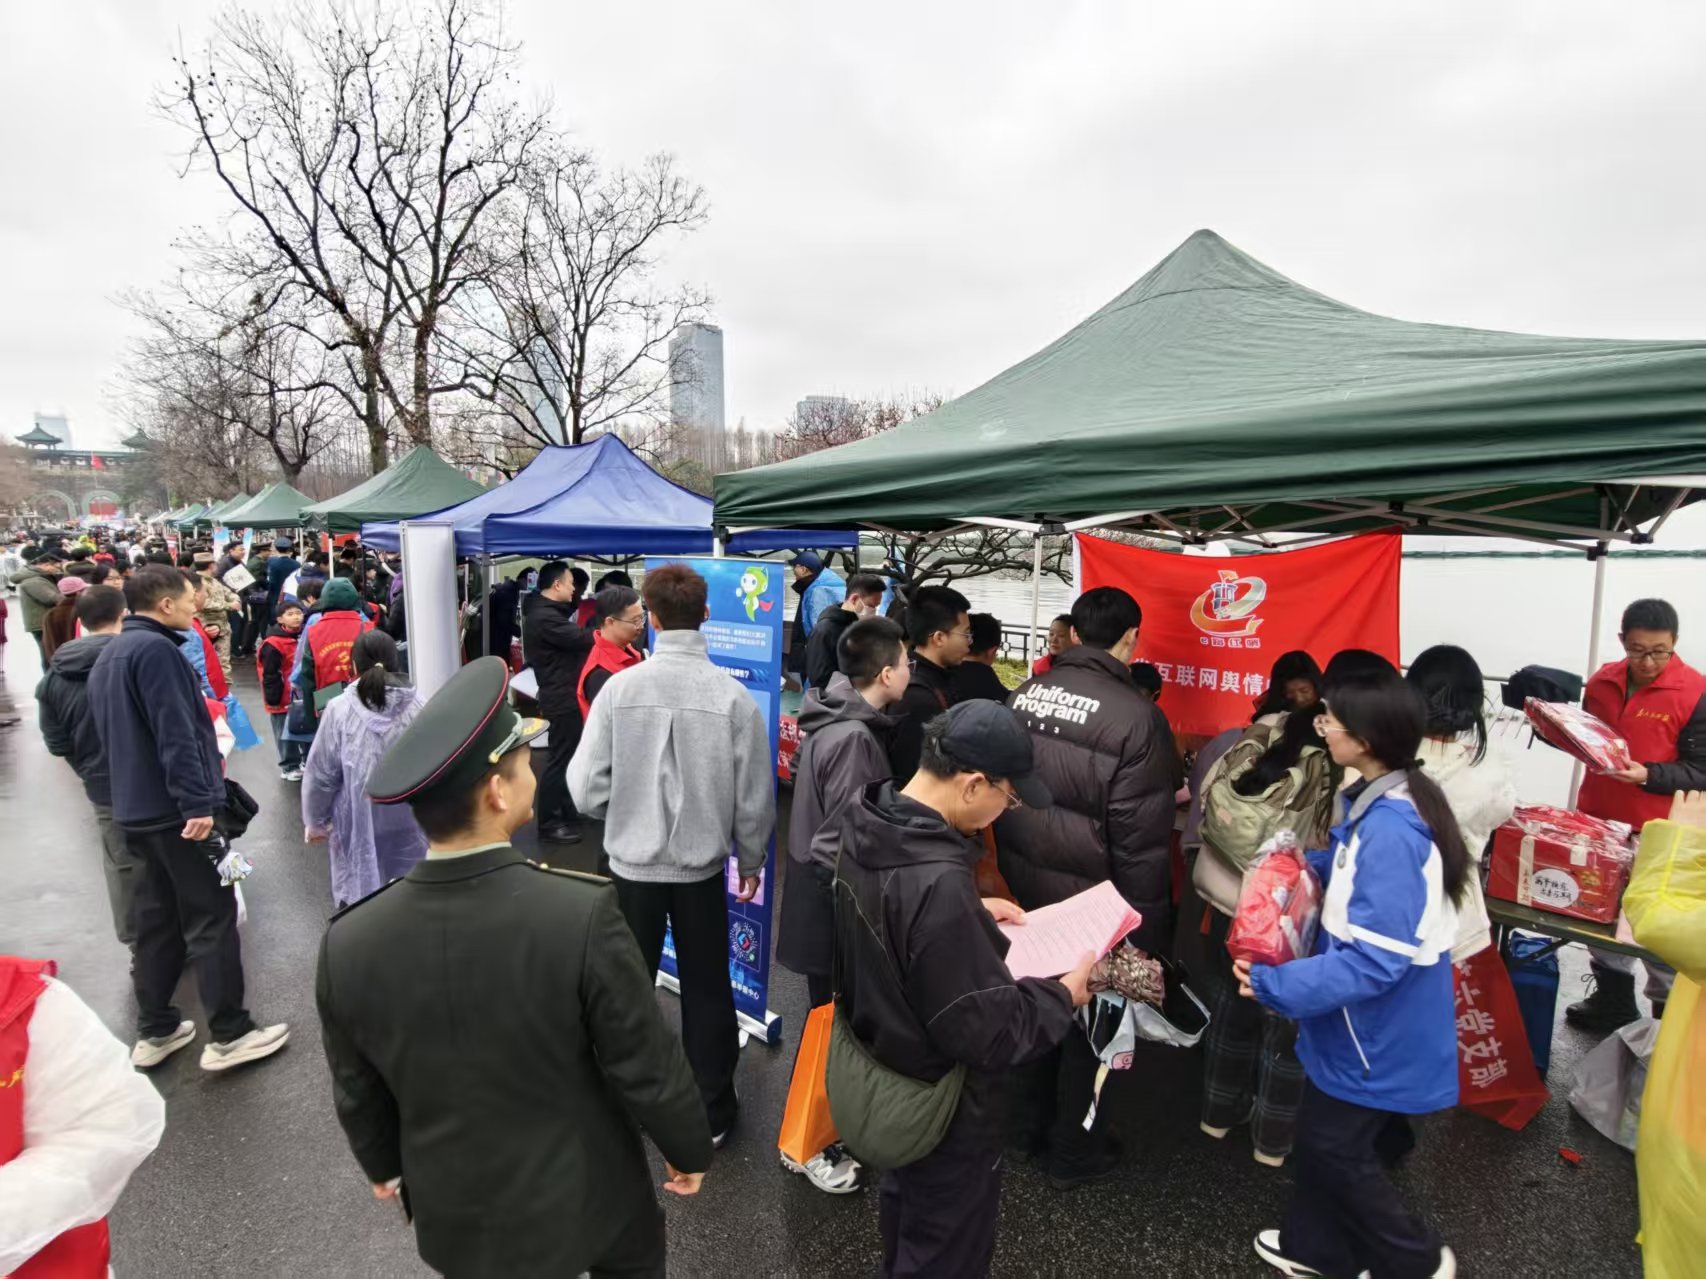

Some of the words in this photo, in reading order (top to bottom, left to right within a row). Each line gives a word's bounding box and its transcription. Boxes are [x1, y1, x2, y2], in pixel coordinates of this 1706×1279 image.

[1135, 658, 1271, 696] 互联网舆情
[1012, 693, 1088, 725] Program
[1026, 683, 1100, 713] Uniform
[1053, 726, 1060, 734] 3
